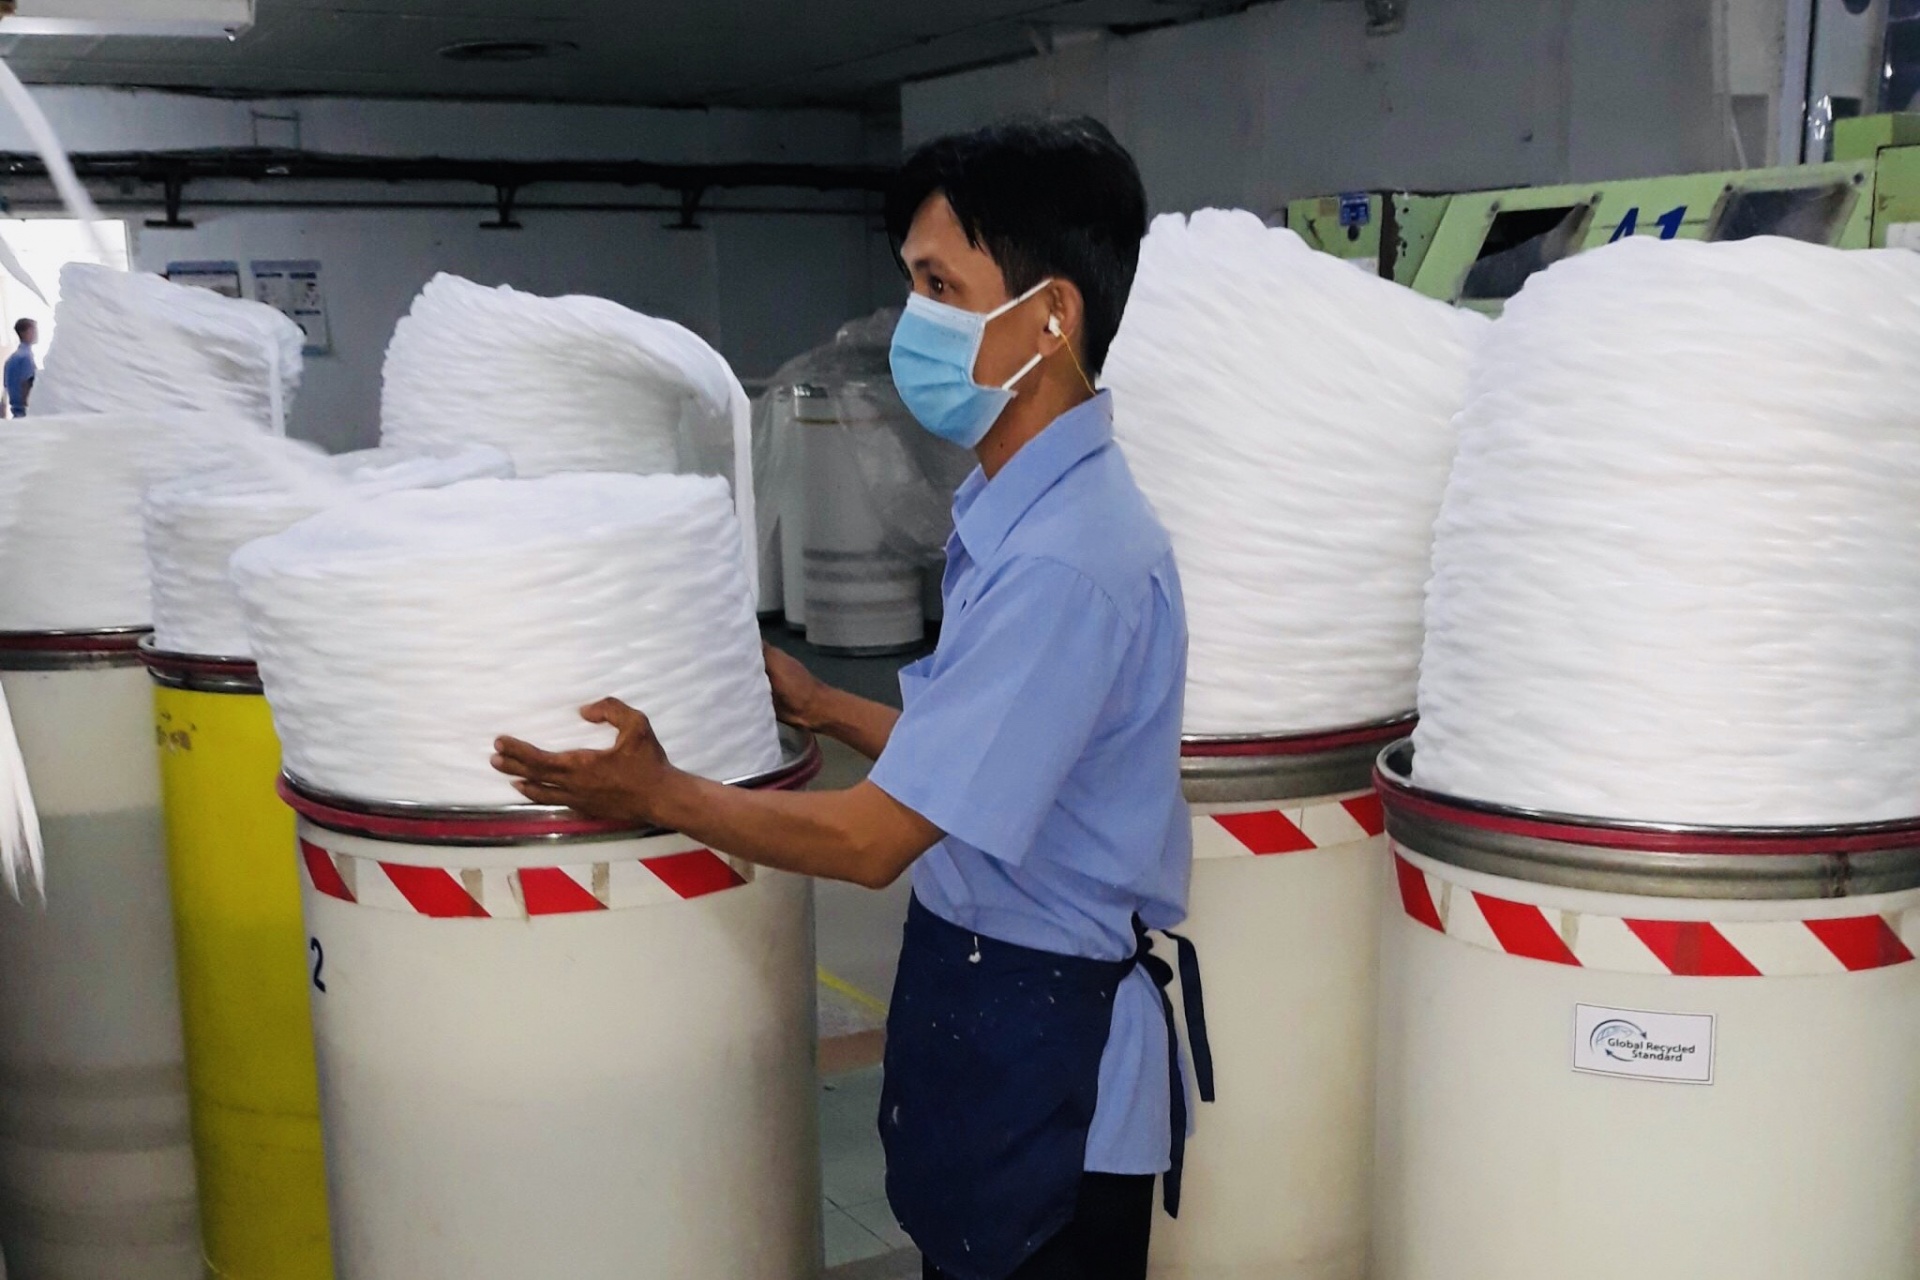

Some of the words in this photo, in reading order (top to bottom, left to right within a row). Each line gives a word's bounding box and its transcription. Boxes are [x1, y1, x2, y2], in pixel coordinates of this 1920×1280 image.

[310, 936, 326, 994] 2
[1607, 1038, 1643, 1050] Global
[1646, 1042, 1696, 1054] Recycled
[1632, 1050, 1682, 1062] Standard
